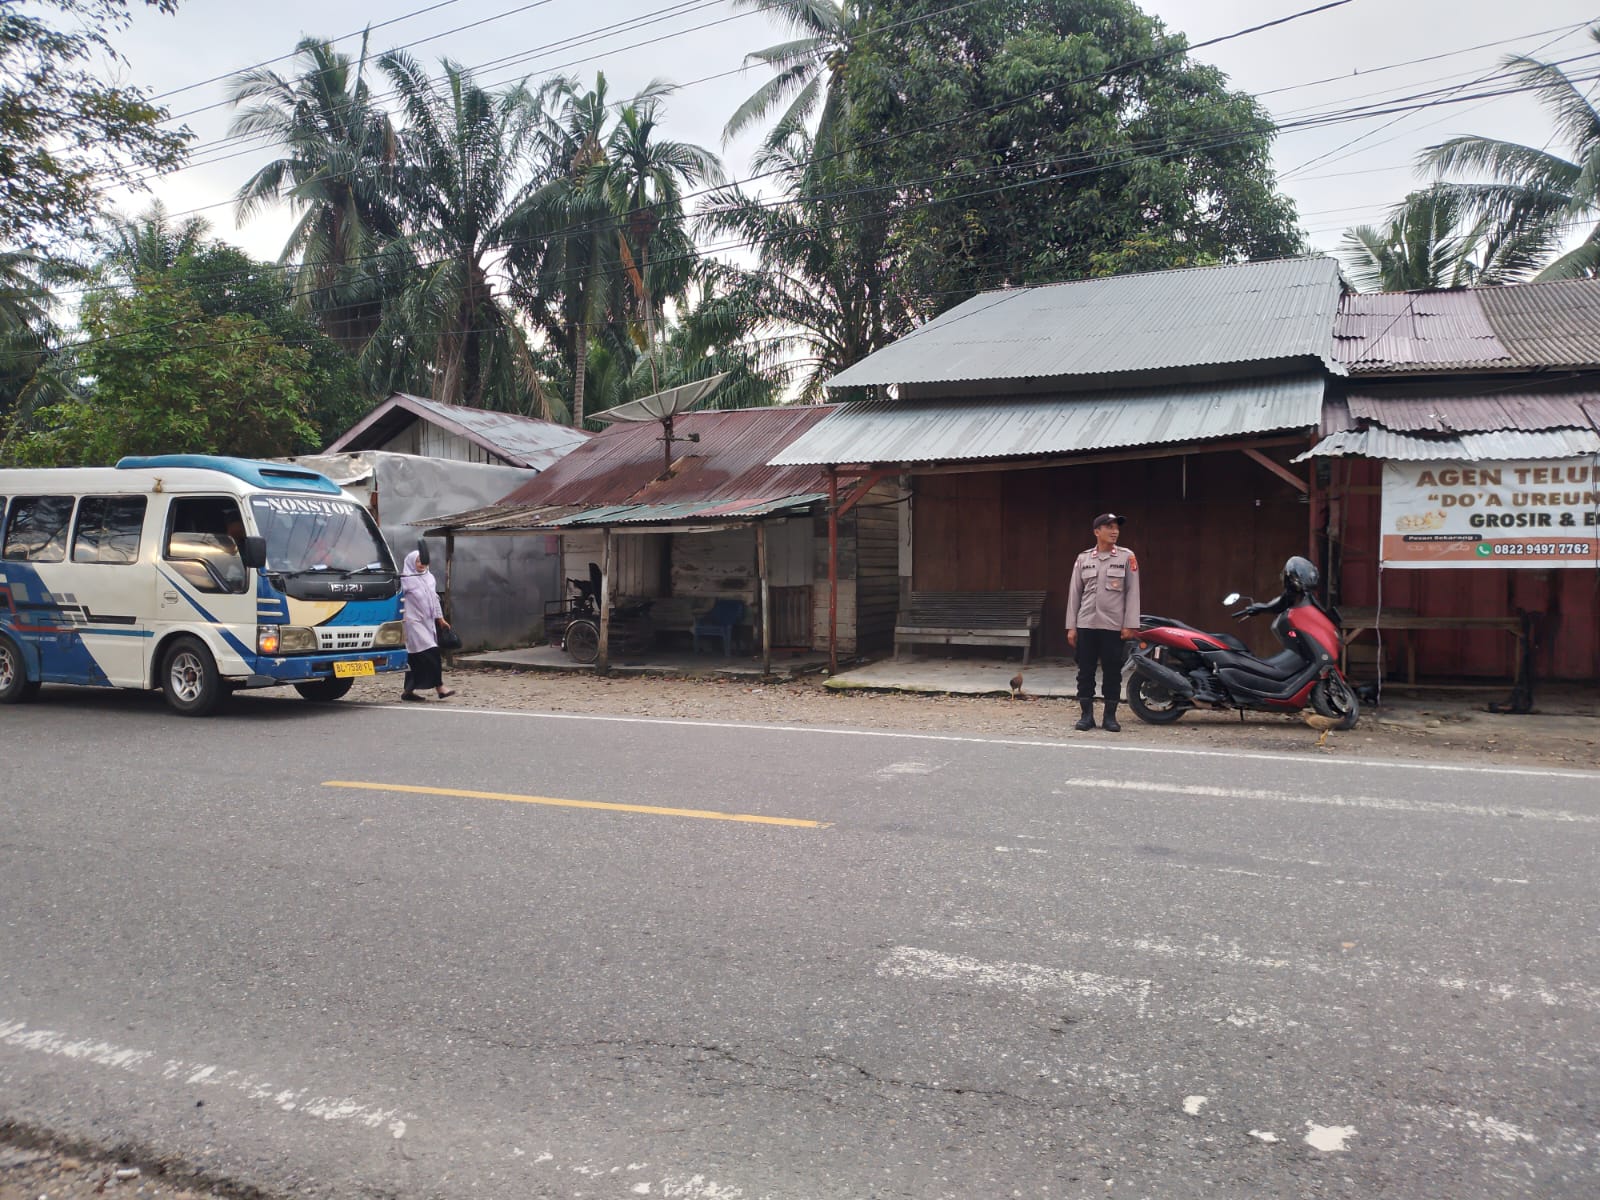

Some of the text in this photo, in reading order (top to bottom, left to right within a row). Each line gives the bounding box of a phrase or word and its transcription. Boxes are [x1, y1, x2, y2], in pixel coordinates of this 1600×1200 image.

[1415, 468, 1502, 488] AGEN
[266, 498, 354, 516] NONSTOP
[1469, 511, 1600, 528] GROSIR & E
[1494, 543, 1589, 555] 0822 9497 7762
[330, 584, 363, 593] ISUZU
